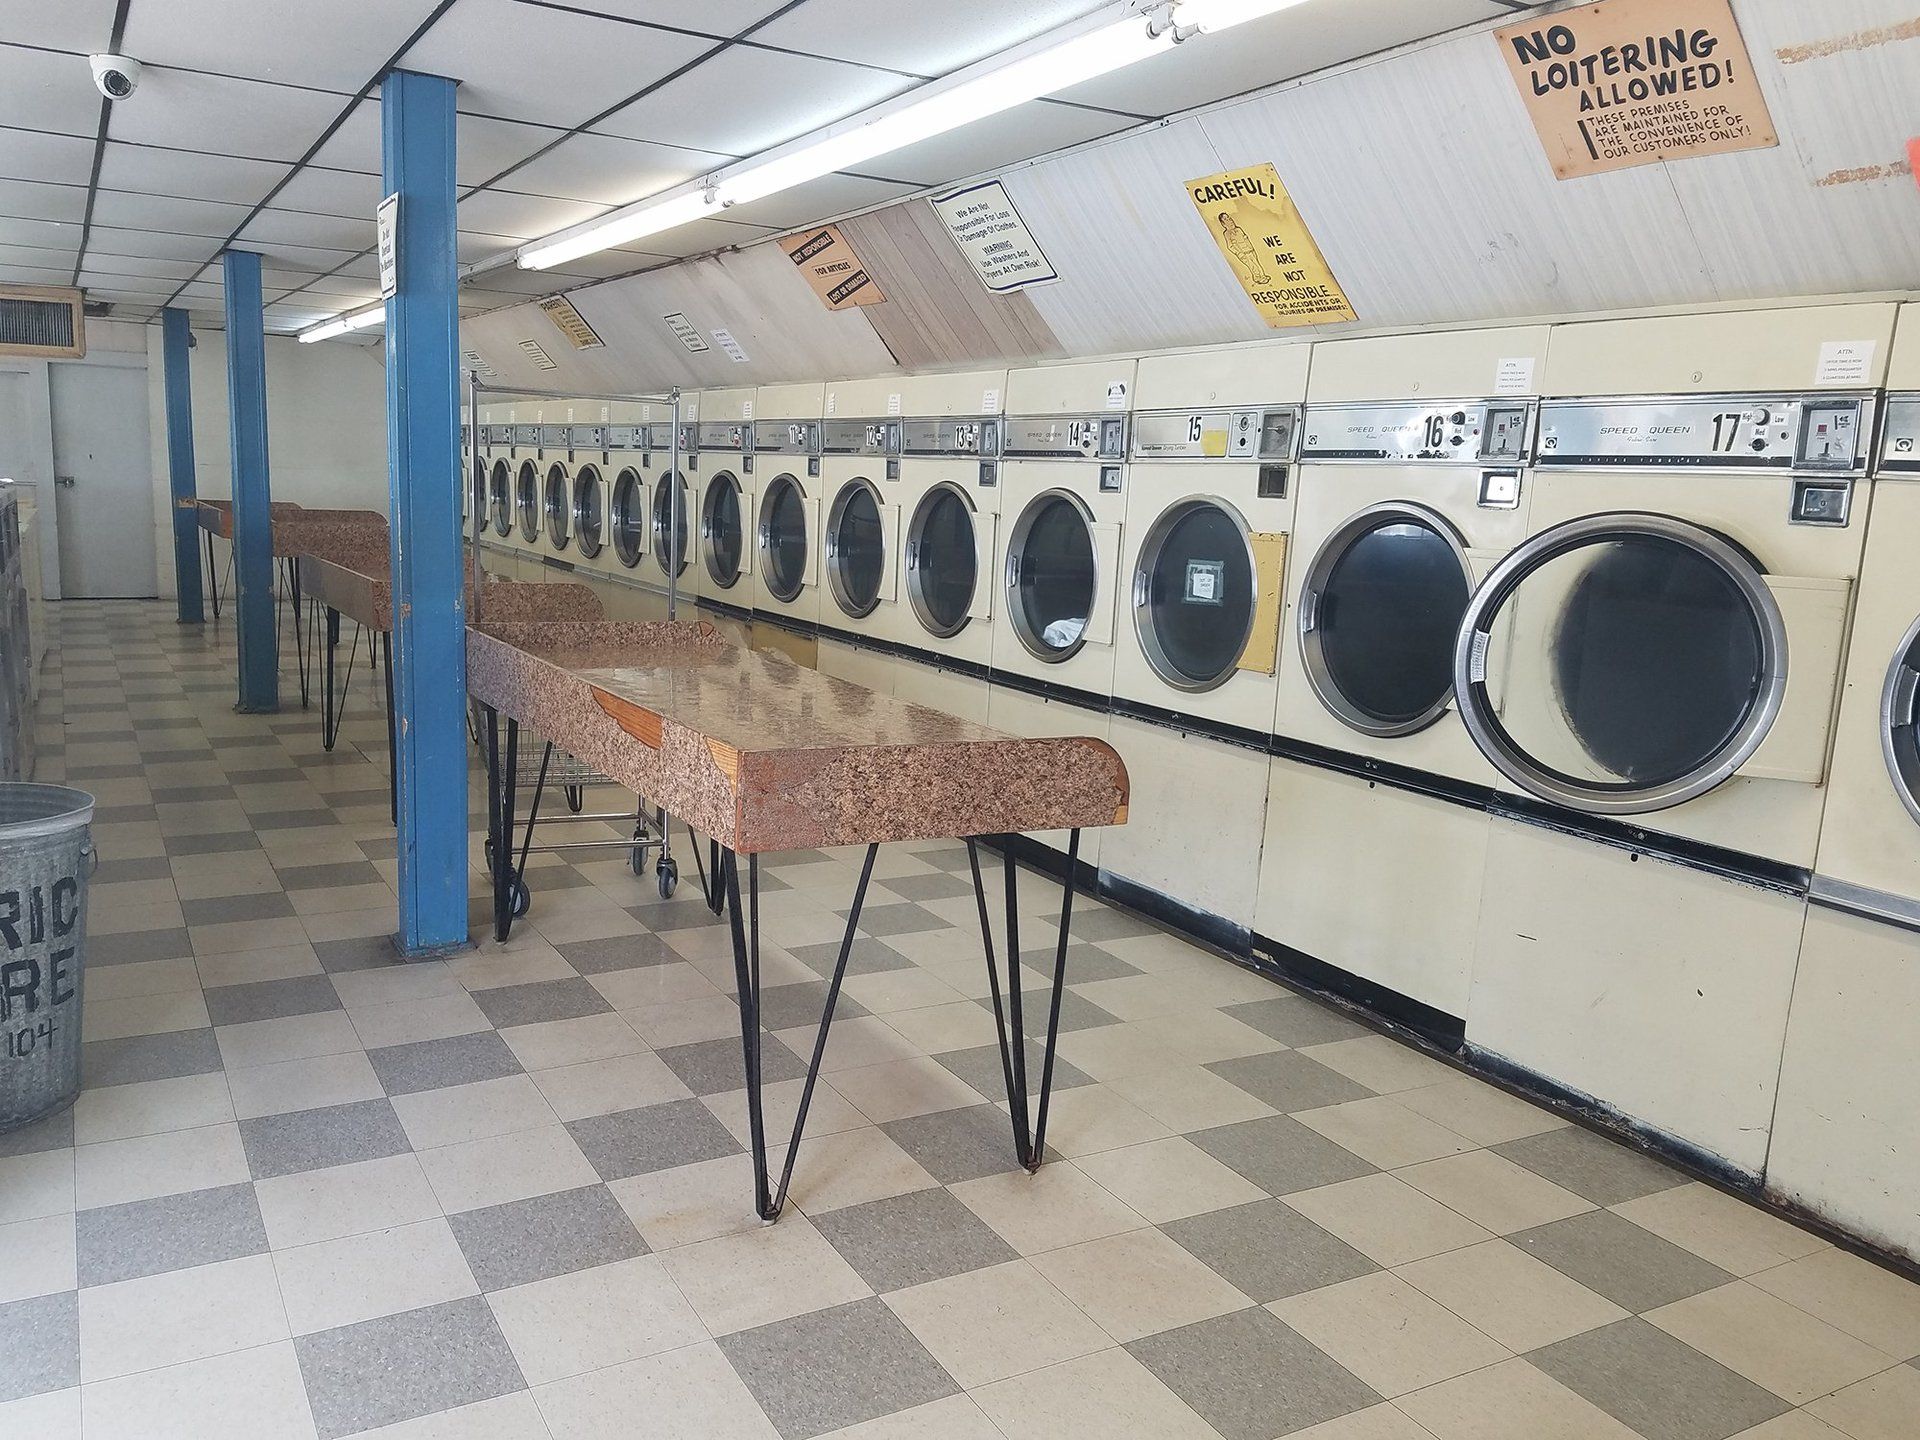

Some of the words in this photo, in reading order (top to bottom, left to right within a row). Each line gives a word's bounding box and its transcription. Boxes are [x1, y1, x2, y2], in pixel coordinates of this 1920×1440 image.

[1511, 25, 1576, 65] NO
[1531, 28, 1718, 96] LOITERING
[1579, 59, 1734, 112] ALLOWED!
[1586, 111, 1626, 127] THESE
[1630, 99, 1690, 118] PREMISES
[1594, 124, 1618, 138] ARE
[1623, 110, 1699, 133] MAINTAINED
[1703, 104, 1729, 118] FOR
[1597, 135, 1624, 148] THE
[1629, 118, 1721, 142] CONVENIENCE
[1725, 114, 1744, 127] OF
[1603, 146, 1631, 159] OUR
[1633, 132, 1706, 154] CUSTOMERS
[1709, 124, 1752, 142] ONLY!
[1194, 177, 1275, 204] CAREFUL!
[955, 210, 968, 219] We
[967, 206, 979, 215] Are
[977, 202, 990, 211] Not
[984, 213, 996, 222] For
[994, 210, 1011, 220] Loss
[962, 229, 988, 242] Damage
[986, 225, 996, 234] Of
[1262, 235, 1283, 248] WE
[981, 239, 1013, 255] WARNING
[991, 252, 1018, 265] Washers
[1016, 248, 1030, 258] And
[814, 266, 827, 276] FOR
[826, 261, 851, 273] ARTICLES
[1002, 265, 1012, 275] At
[1010, 263, 1026, 272] Own
[1274, 252, 1296, 266] ARE
[1283, 270, 1307, 283] NOT
[1273, 302, 1290, 310] FOR
[1289, 299, 1329, 310] ACCIDENTS
[1329, 297, 1343, 305] OR
[1277, 307, 1306, 316] INJURIES
[956, 426, 965, 448] 13
[1069, 422, 1080, 446] 14
[1188, 416, 1202, 442] 15
[1425, 415, 1444, 448] 16
[1600, 426, 1638, 435] SPEED
[1649, 426, 1691, 434] QUEEN
[1712, 413, 1741, 452] 17
[8, 1017, 59, 1058] 104
